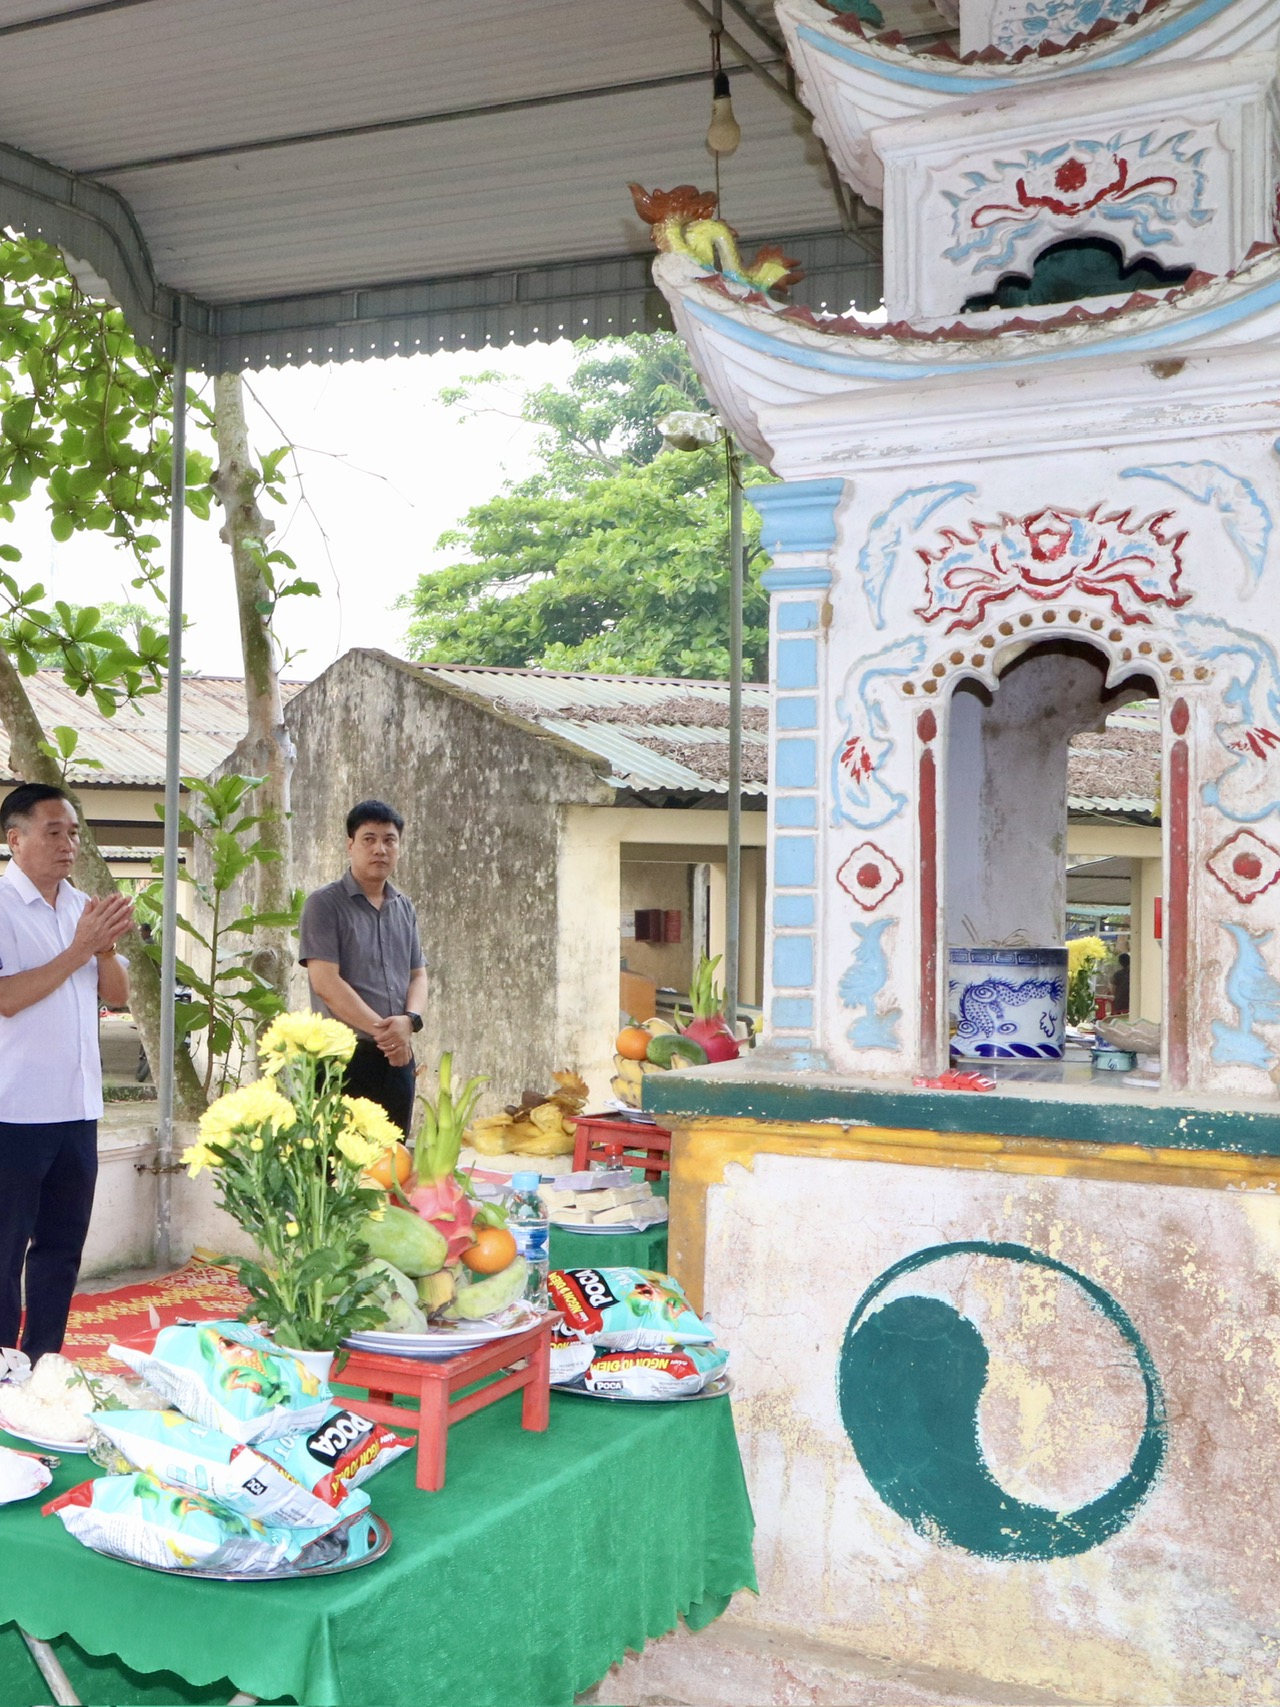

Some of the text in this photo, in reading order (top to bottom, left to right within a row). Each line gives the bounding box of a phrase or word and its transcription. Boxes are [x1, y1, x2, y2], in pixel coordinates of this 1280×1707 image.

[575, 1269, 613, 1309] POCA
[596, 1380, 623, 1390] POCA
[309, 1411, 374, 1457] POCA
